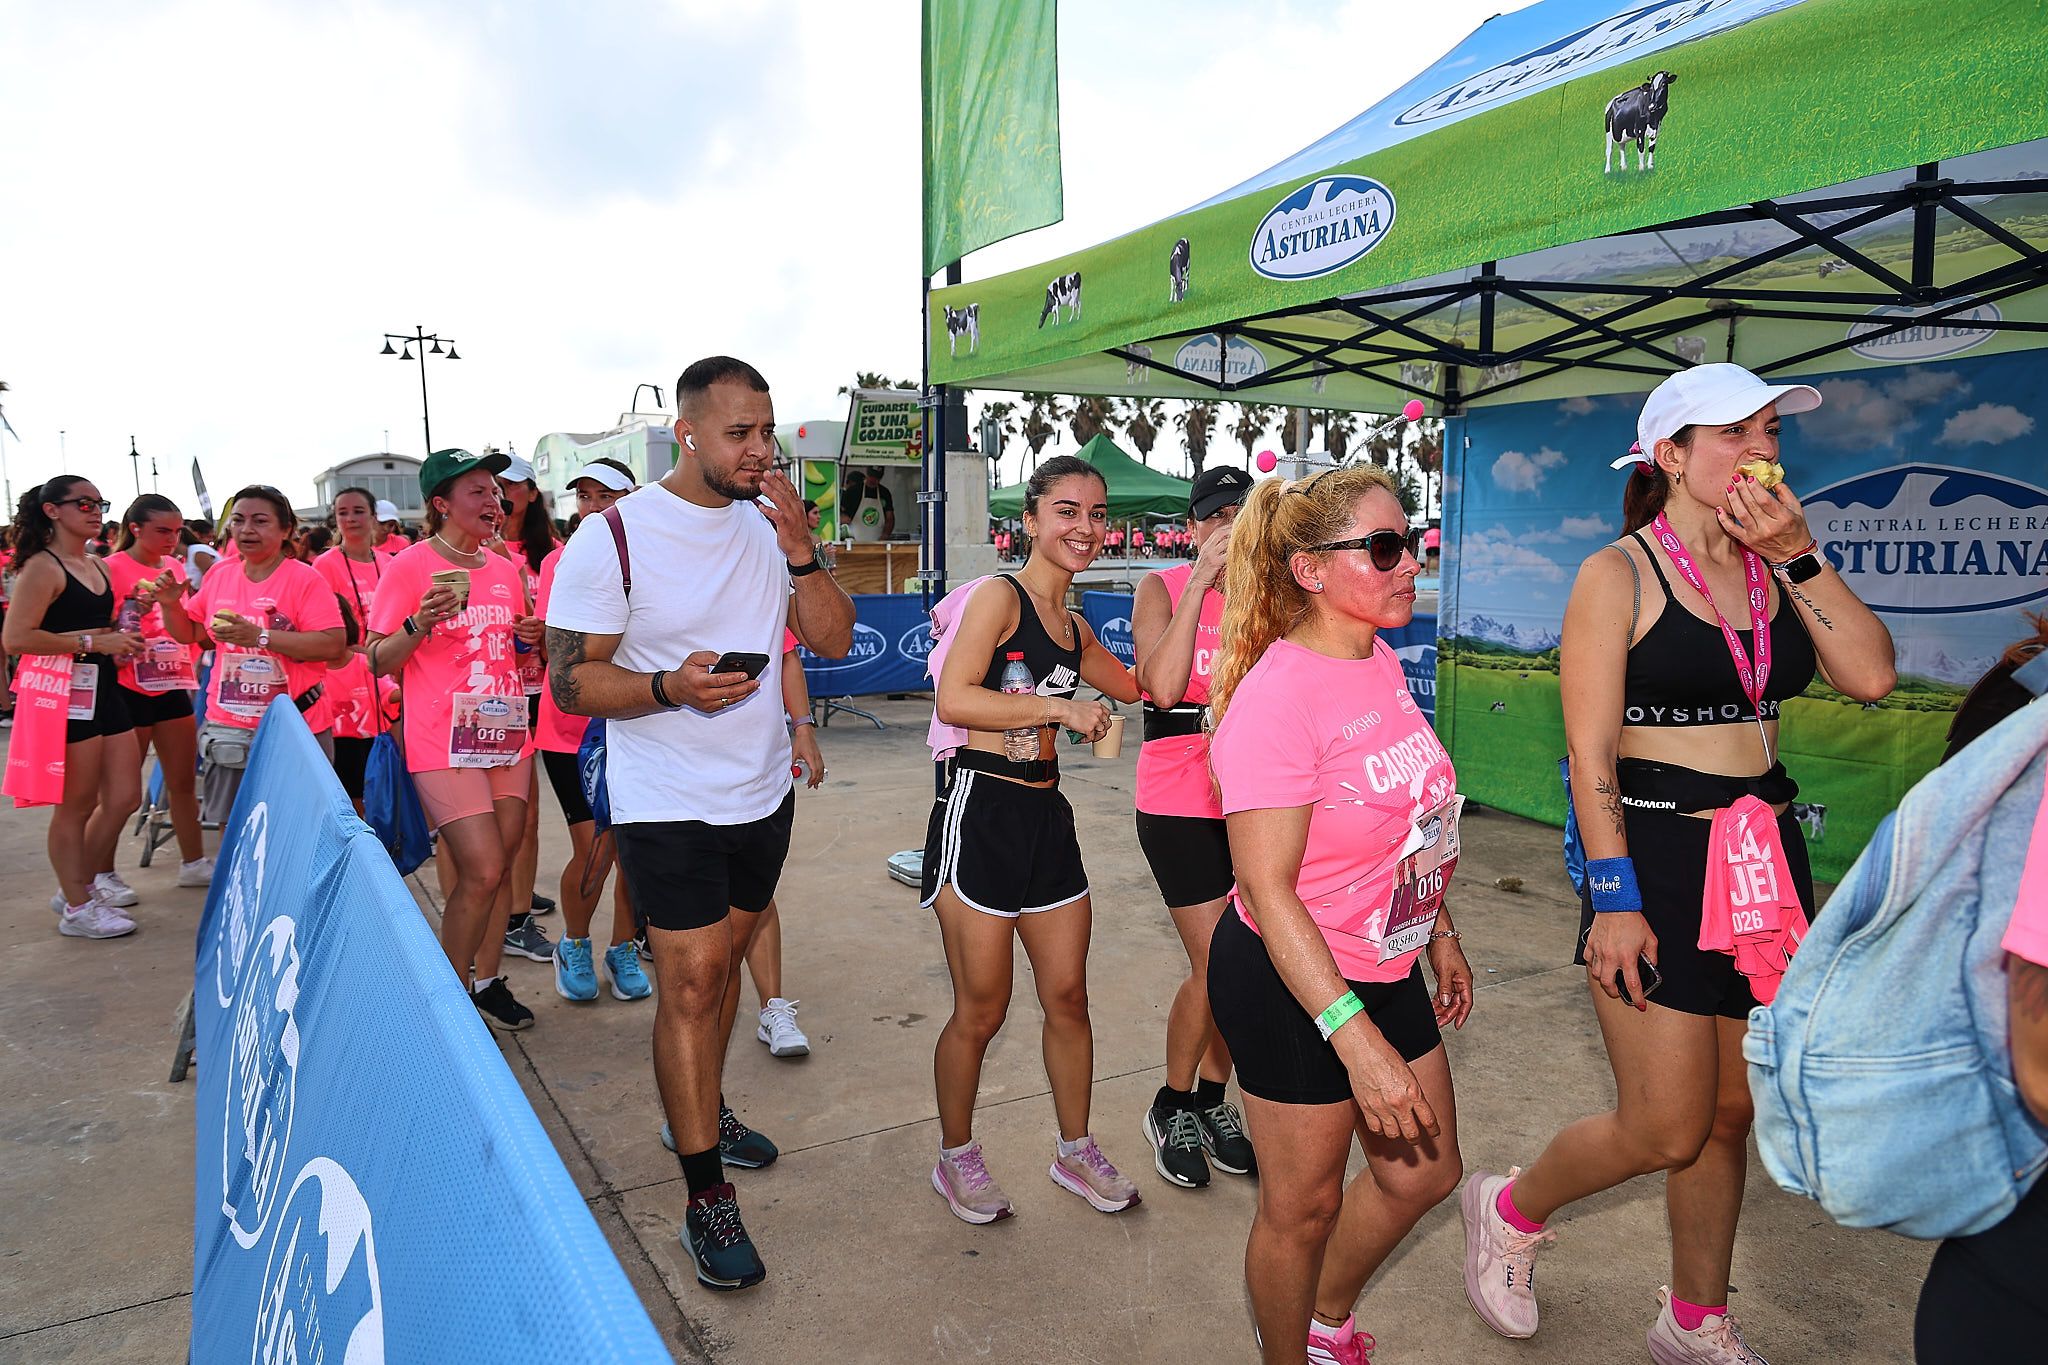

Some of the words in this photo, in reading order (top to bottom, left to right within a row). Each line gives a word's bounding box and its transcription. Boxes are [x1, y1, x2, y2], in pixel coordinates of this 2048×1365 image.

[1281, 211, 1325, 232] CENTRAL
[1329, 195, 1377, 217] LECHERA
[1259, 209, 1381, 265] ASTURIANA
[862, 403, 910, 414] CUIDARSE
[861, 416, 875, 428] ES
[880, 414, 908, 427] UNA
[859, 428, 913, 442] GOZADA
[1828, 518, 1927, 532] CENTRAL
[1823, 539, 2048, 577] STURIANA
[487, 632, 507, 660] DE
[156, 660, 183, 671] 016
[1048, 663, 1078, 688] NIKE
[240, 682, 270, 694] 016
[477, 728, 507, 741] 016
[1342, 709, 1381, 741] OYSHO
[1364, 726, 1446, 794] CARRERA
[1620, 796, 1676, 810] ALOMON
[1417, 867, 1443, 900] 016
[1388, 931, 1418, 951] OYSHO
